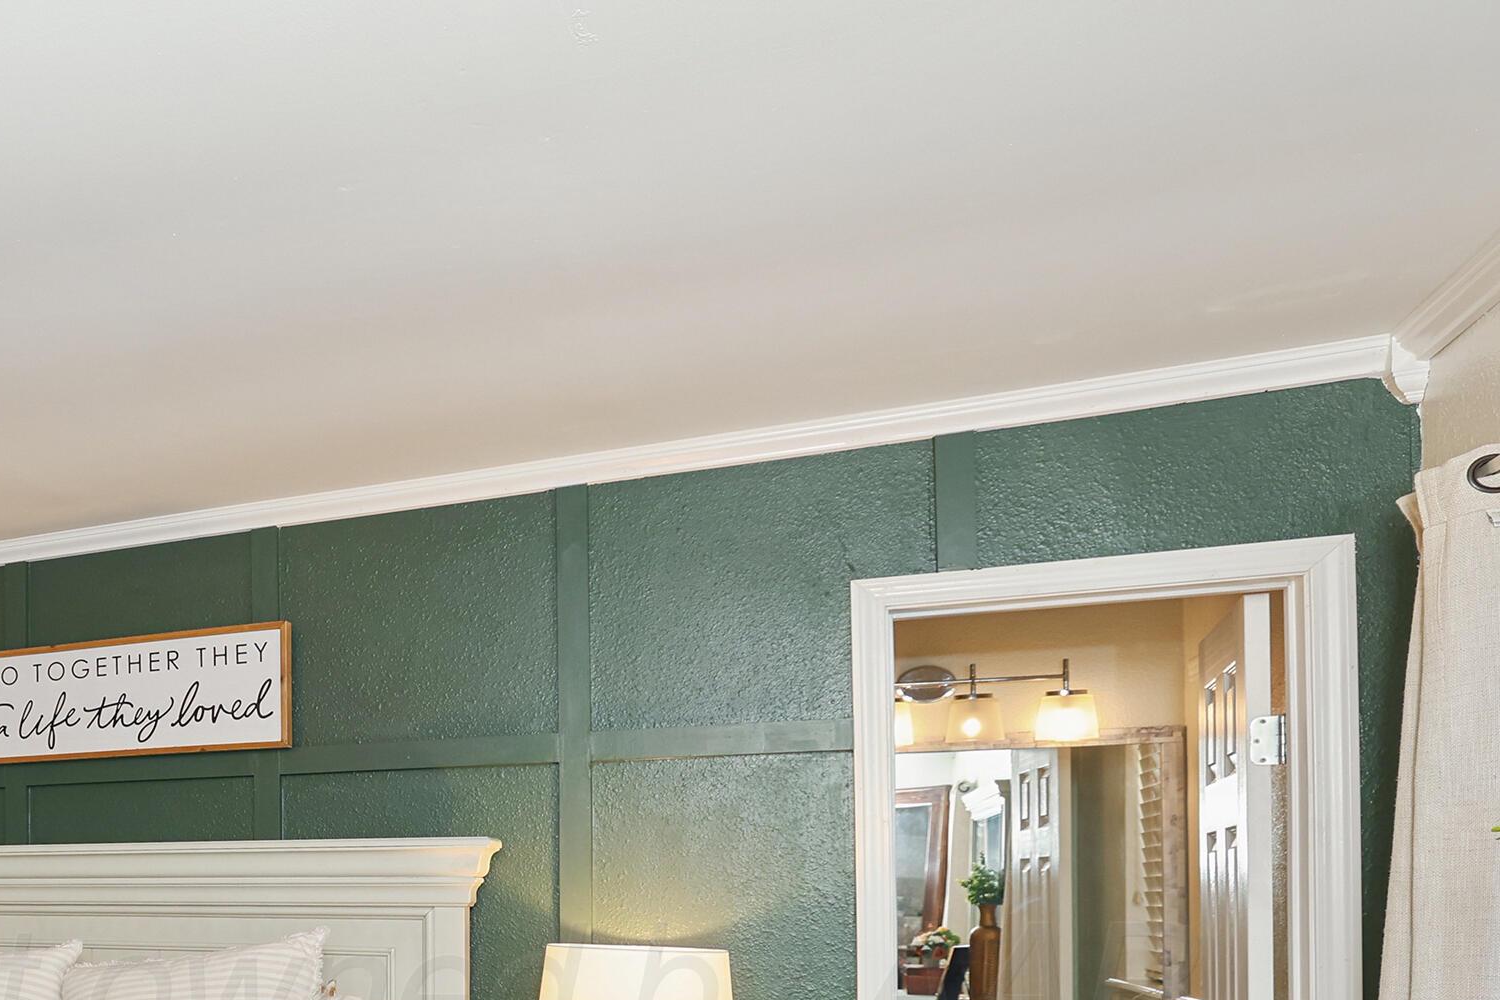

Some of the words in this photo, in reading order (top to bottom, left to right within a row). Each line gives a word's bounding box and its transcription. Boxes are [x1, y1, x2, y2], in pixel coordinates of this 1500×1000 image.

[33, 650, 179, 683] TOGETHER
[195, 641, 268, 668] THEY
[18, 691, 81, 750] life
[83, 692, 175, 743] they
[170, 678, 274, 728] loved
